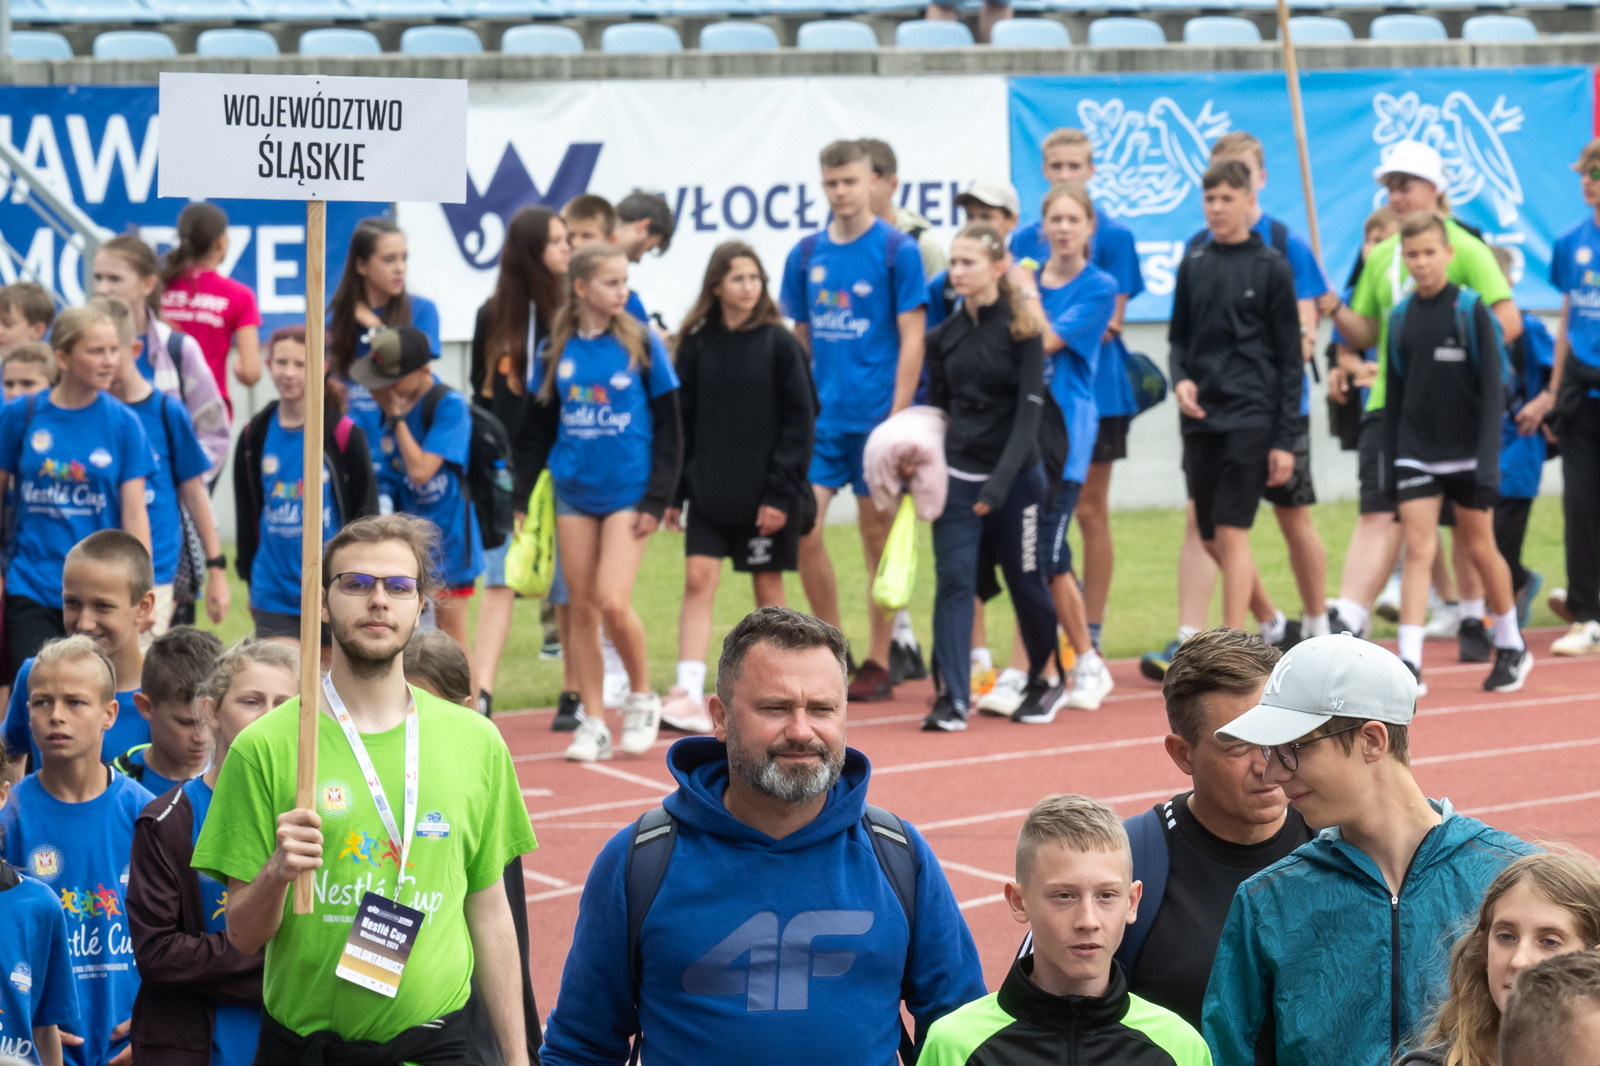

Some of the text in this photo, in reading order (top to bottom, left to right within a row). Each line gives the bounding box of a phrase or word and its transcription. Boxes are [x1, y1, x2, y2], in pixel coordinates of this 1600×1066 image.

[223, 91, 403, 131] WOJEWÓDZTWO
[258, 133, 366, 186] ŚLĄSKIE
[72, 482, 107, 514] Cup
[361, 916, 390, 937] Nestlé
[390, 927, 407, 944] Cup
[345, 942, 405, 976] WOLONTARIUSZ
